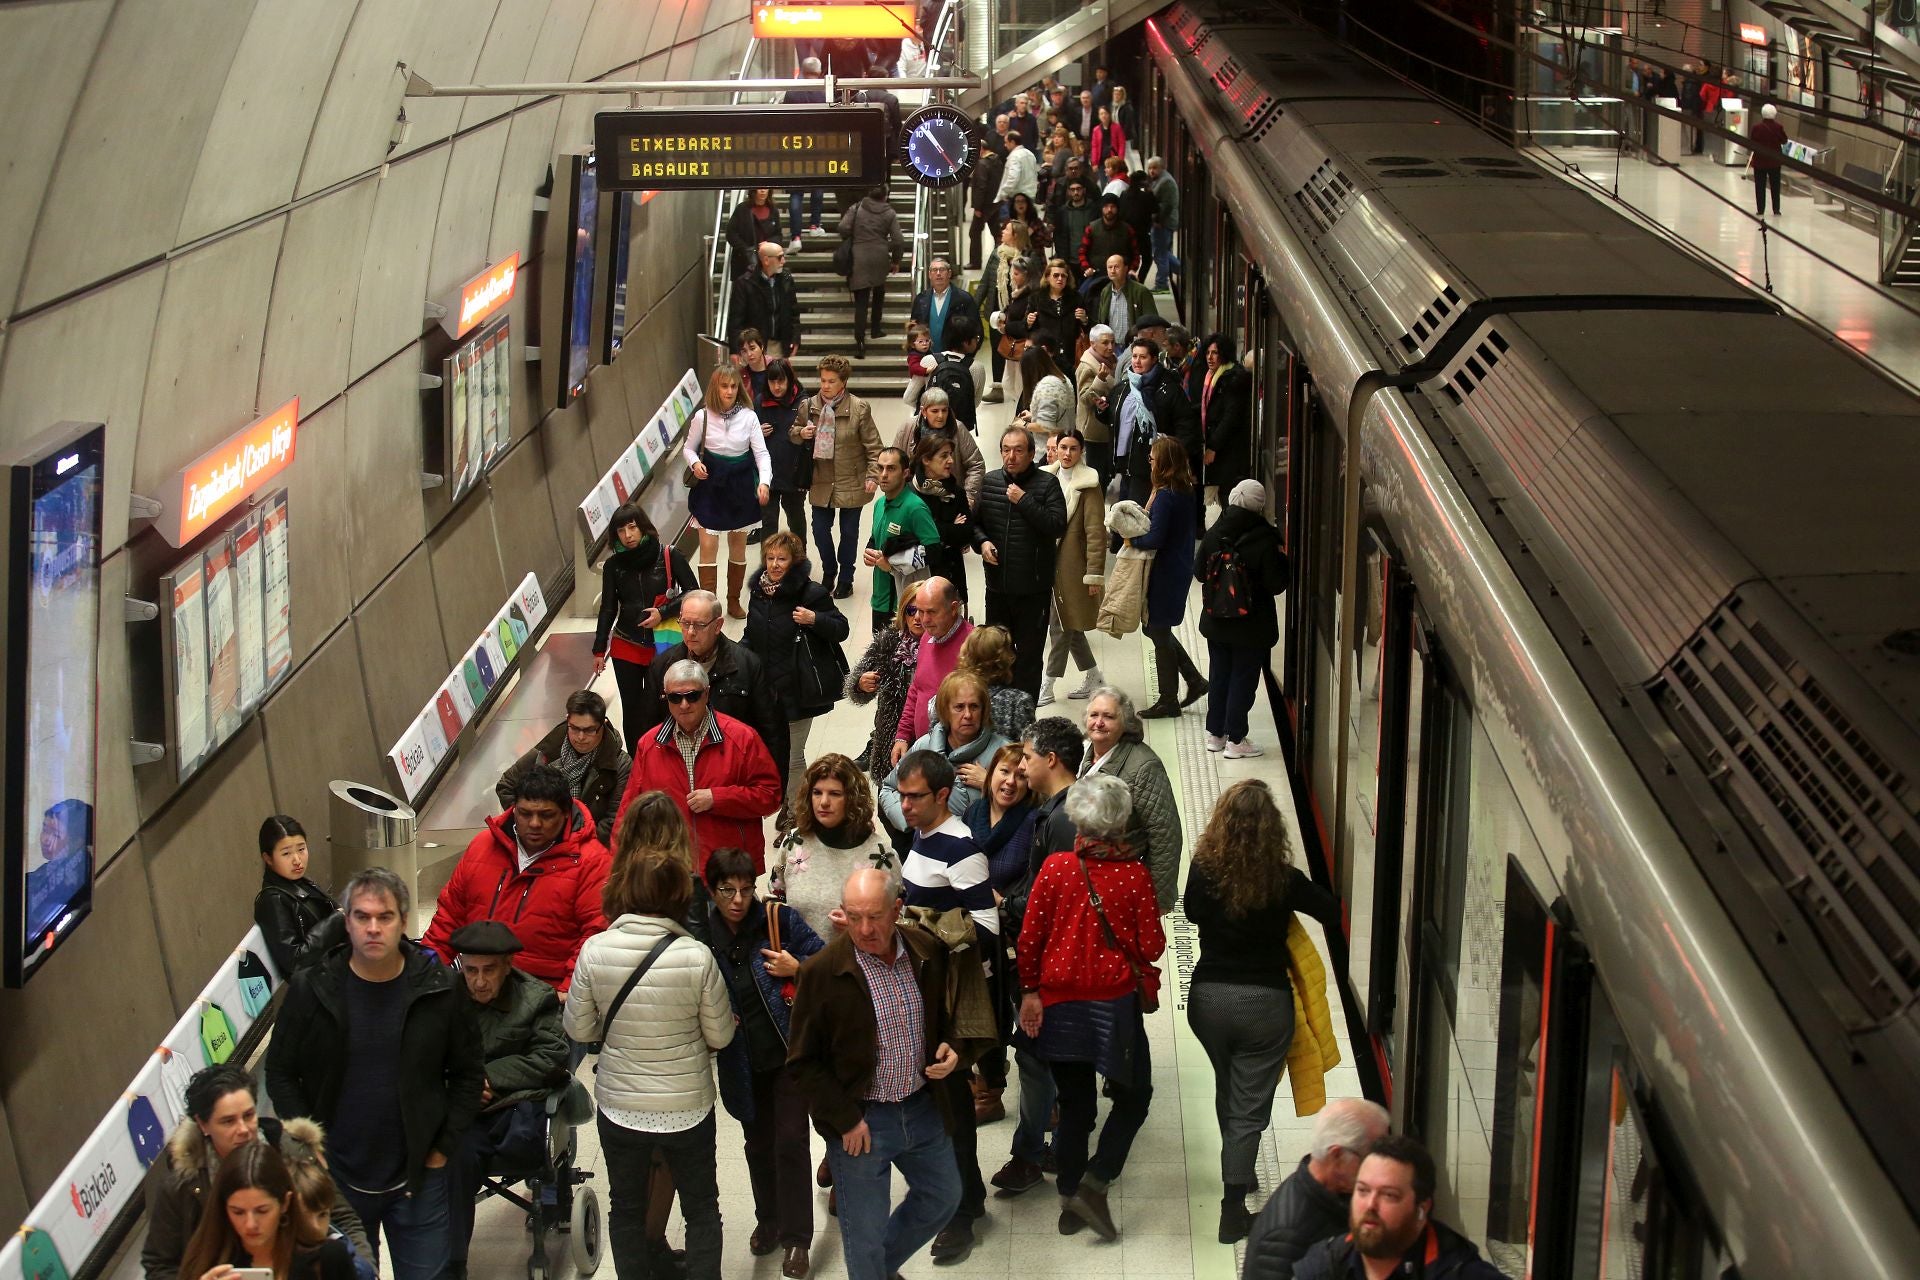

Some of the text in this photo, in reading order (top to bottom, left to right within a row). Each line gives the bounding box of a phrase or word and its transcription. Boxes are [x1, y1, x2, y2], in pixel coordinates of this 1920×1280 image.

[630, 136, 814, 152] ETXEBARRI (5)
[632, 160, 849, 177] BASAURI 04
[1166, 915, 1197, 934] geldi
[1168, 936, 1198, 979] dagoenean
[80, 1162, 117, 1219] Bizkaia
